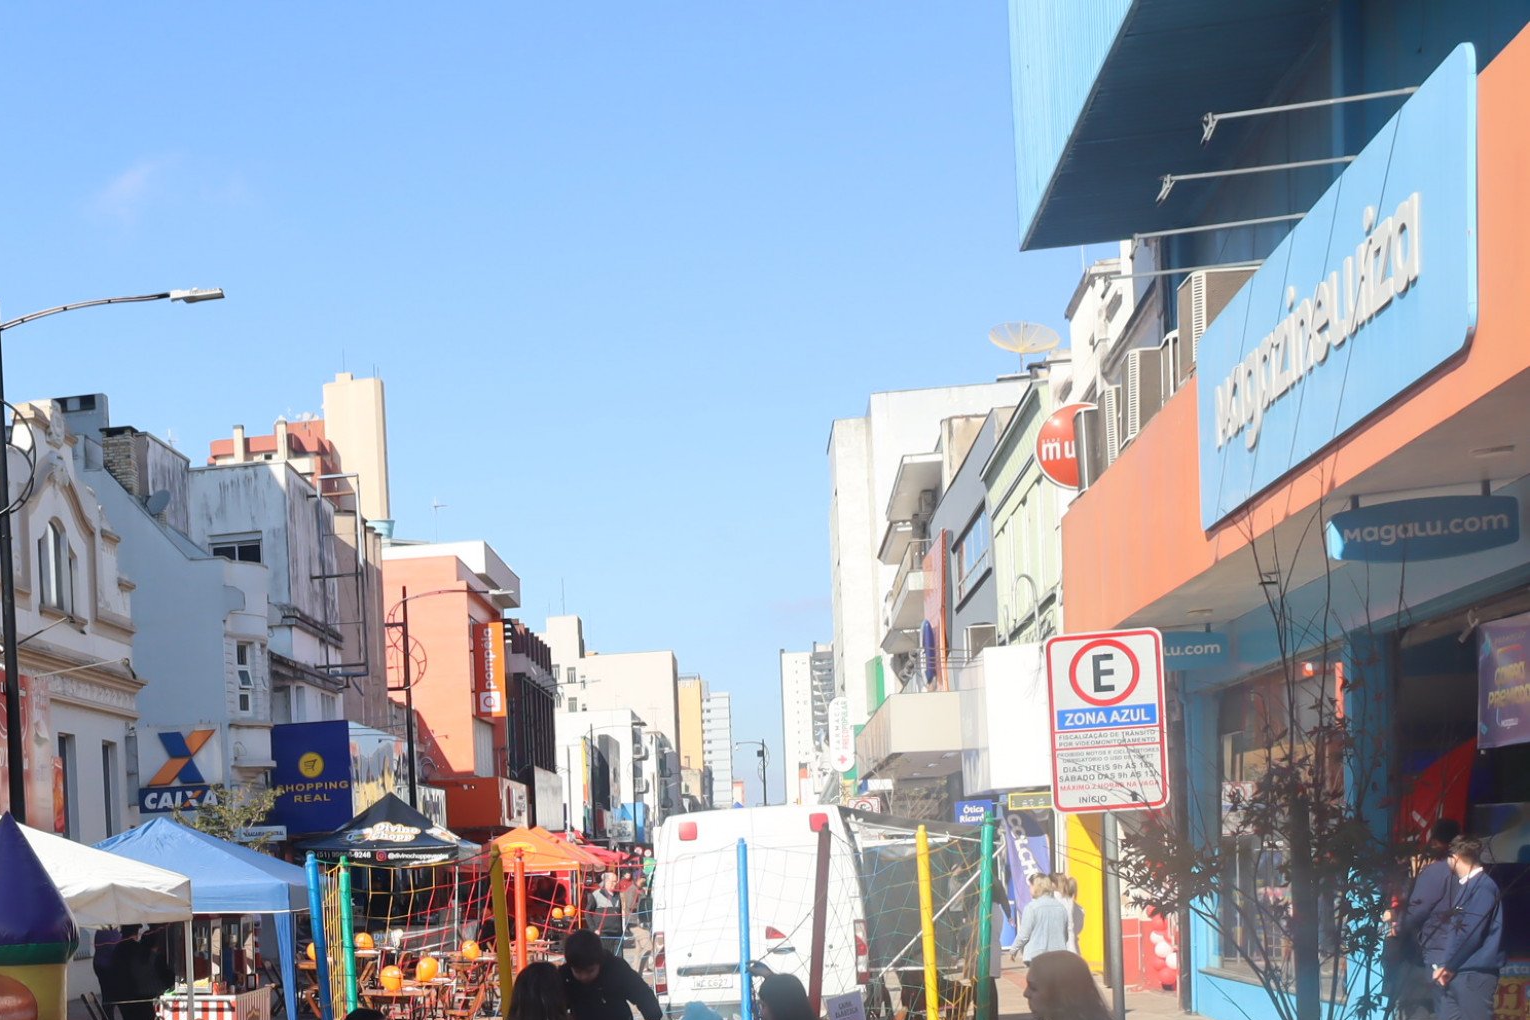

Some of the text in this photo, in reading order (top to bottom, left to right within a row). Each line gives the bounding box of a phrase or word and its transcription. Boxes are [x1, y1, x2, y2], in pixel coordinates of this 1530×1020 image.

[1091, 653, 1116, 694] E
[1064, 708, 1151, 727] ZONA AZUL
[1062, 765, 1083, 774] DIAS
[1112, 762, 1123, 770] 9h
[1097, 772, 1116, 780] DAS
[1117, 770, 1128, 779] 9h
[277, 780, 349, 793] SHOPPING
[144, 789, 219, 810] CAIXA
[294, 792, 332, 803] REAL
[962, 804, 985, 814] Ótica
[959, 813, 985, 824] Ricard
